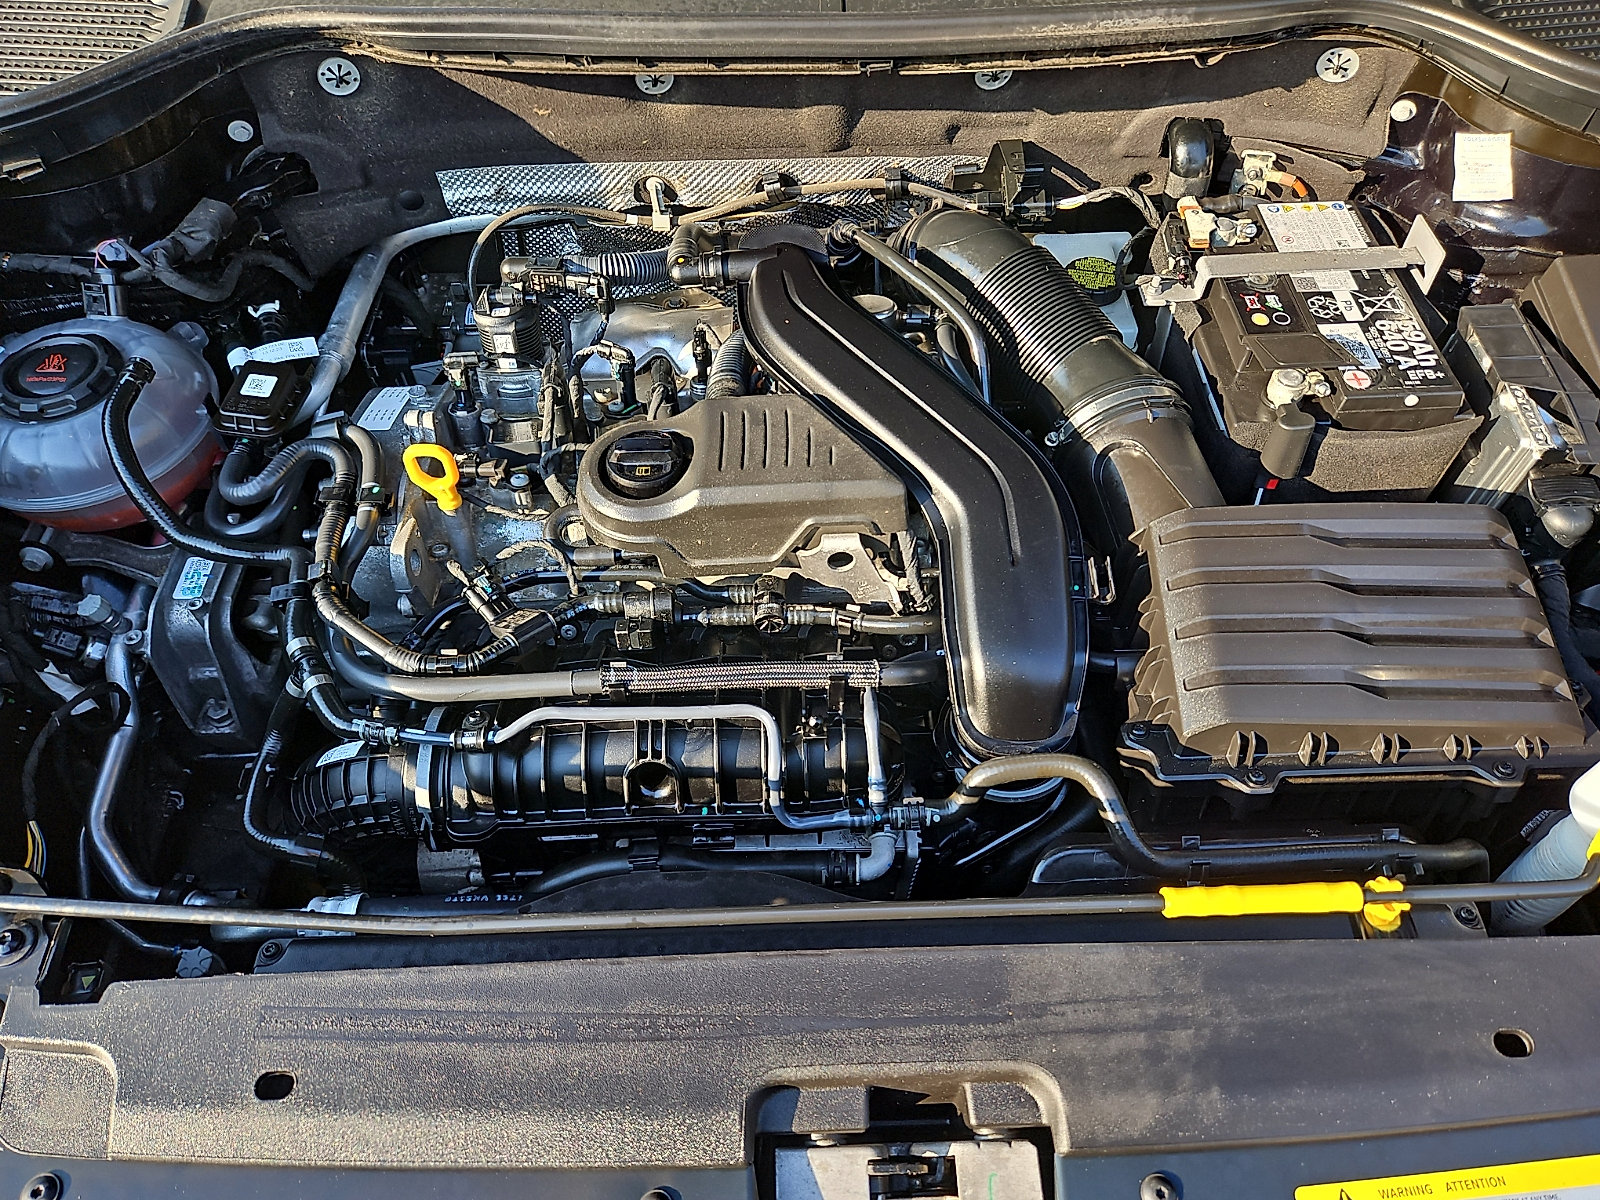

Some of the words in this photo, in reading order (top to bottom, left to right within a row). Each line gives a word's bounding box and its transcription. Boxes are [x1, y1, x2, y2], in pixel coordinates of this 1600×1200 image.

[1374, 319, 1410, 352] 640
[1398, 318, 1440, 367] 59Ah
[1406, 369, 1445, 380] EFB+
[1378, 1183, 1433, 1199] WARNING
[1445, 1175, 1507, 1193] ATTENTION
